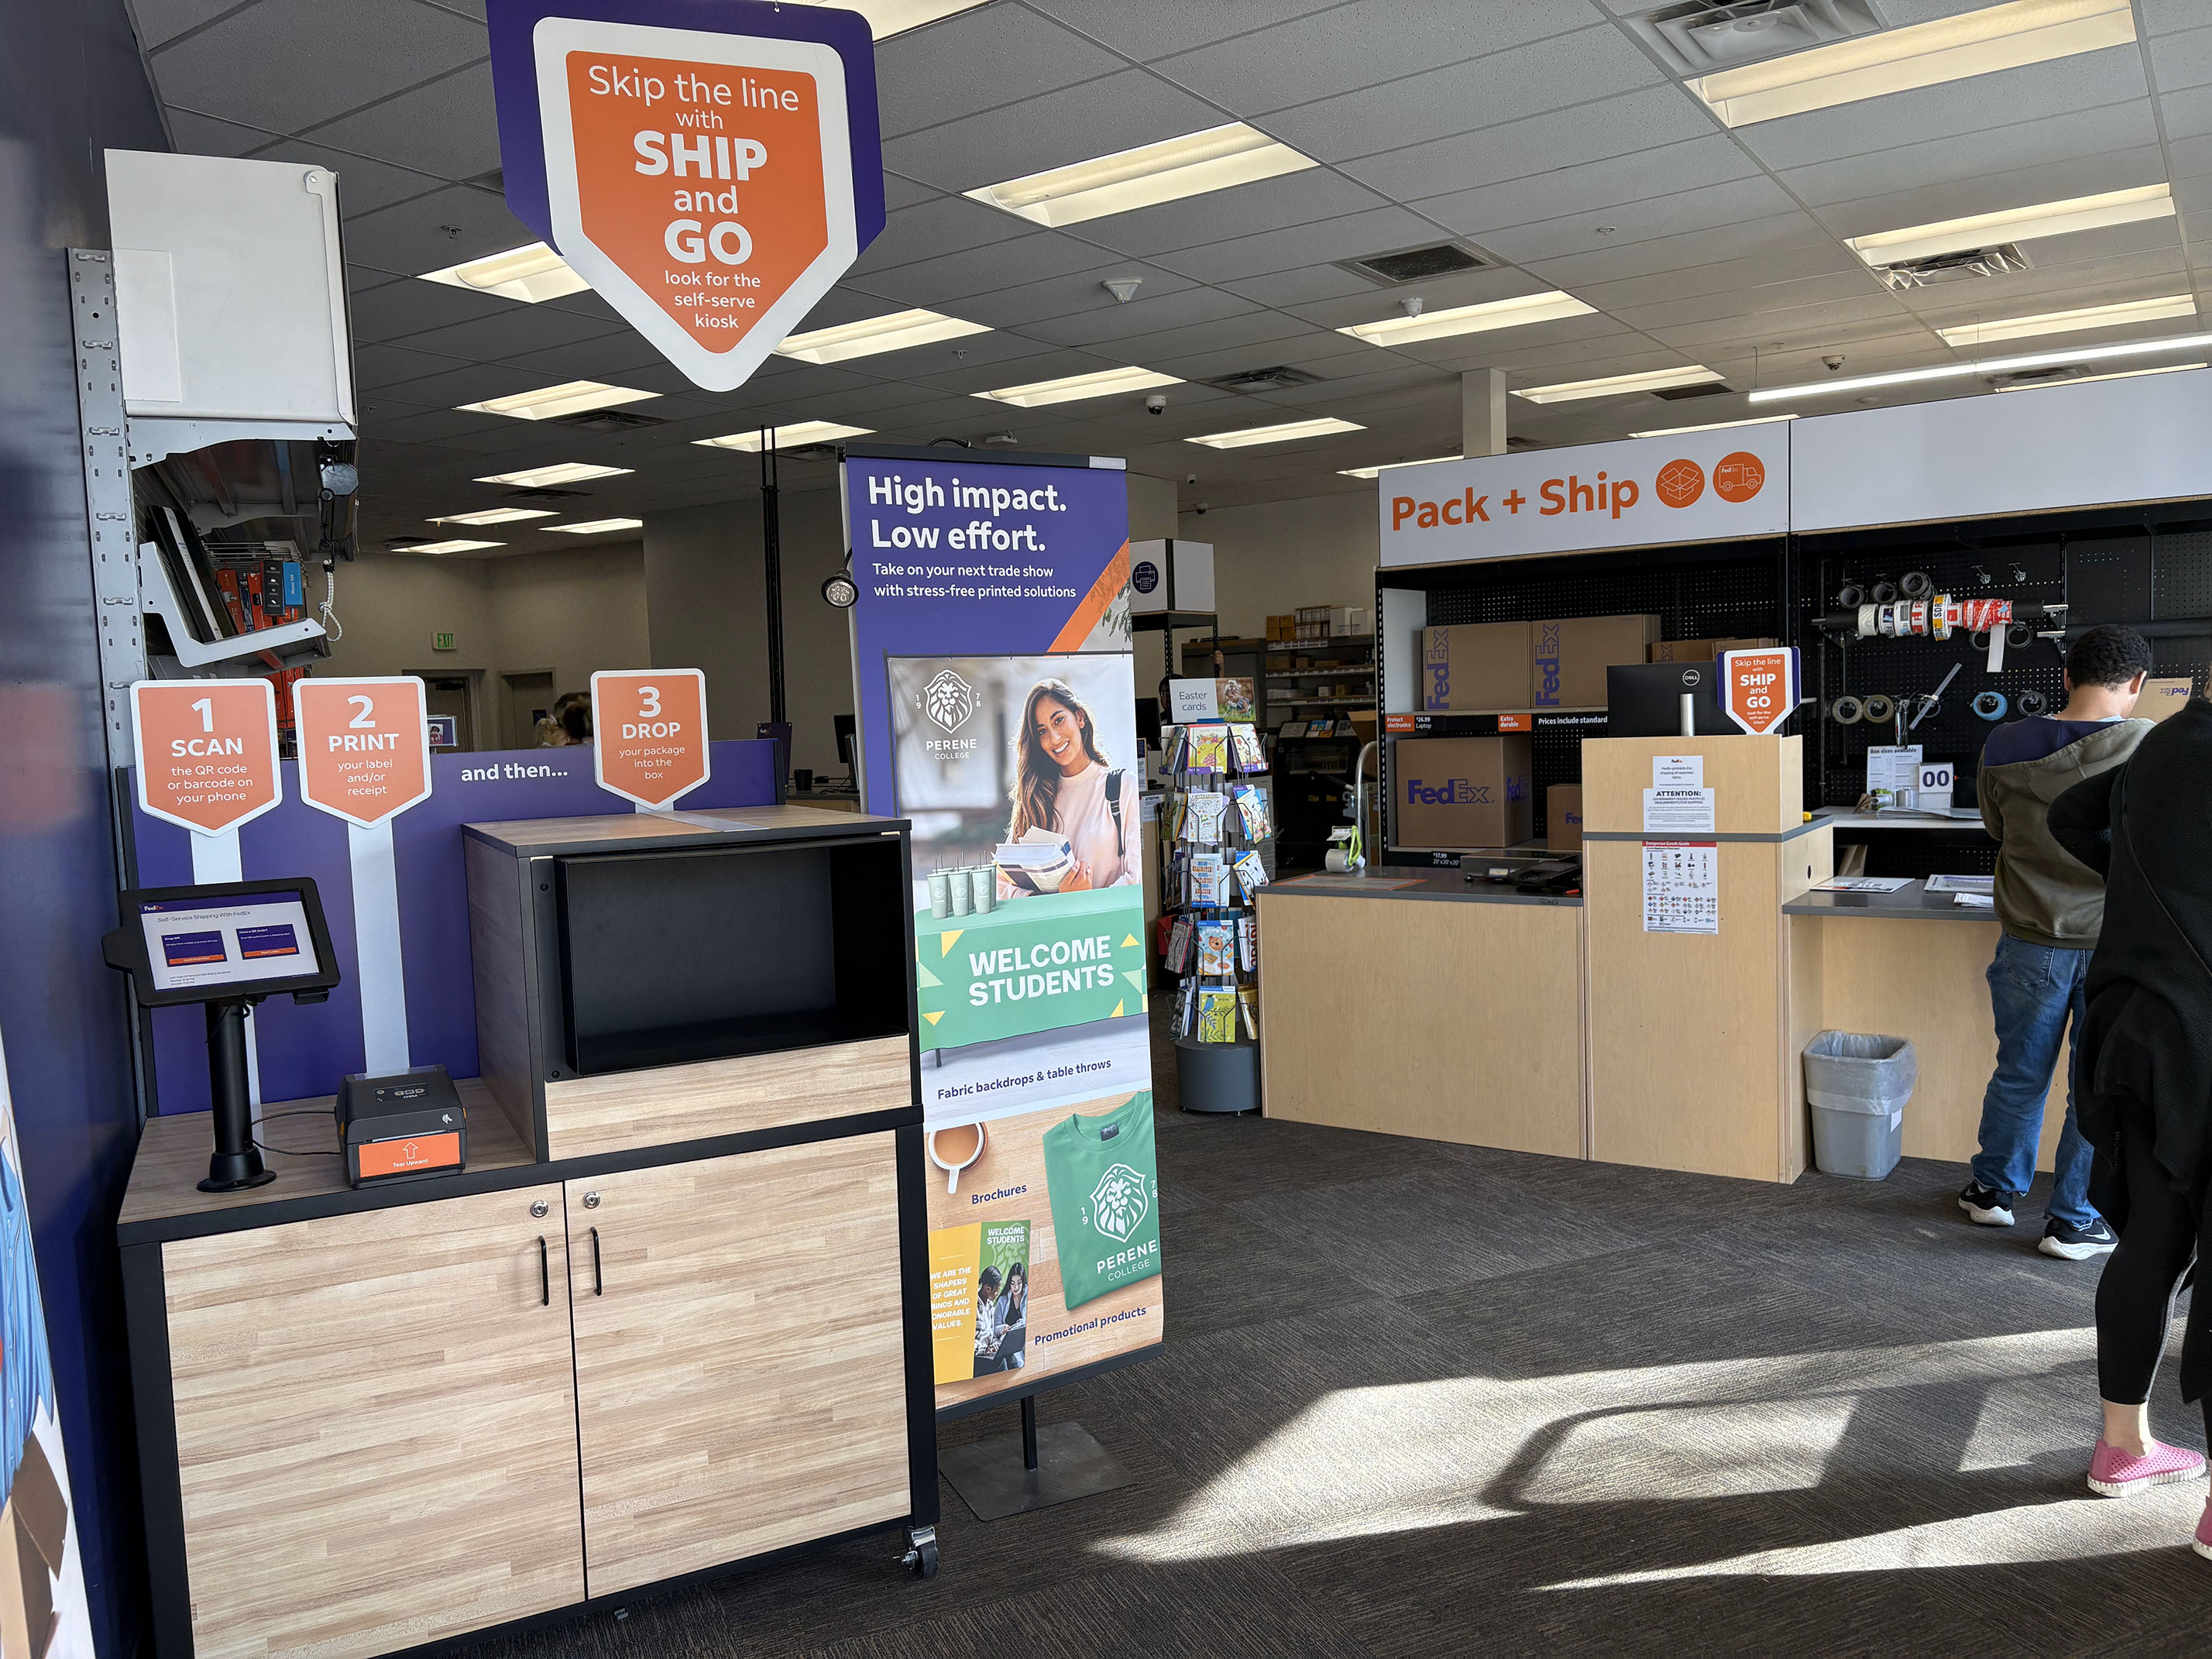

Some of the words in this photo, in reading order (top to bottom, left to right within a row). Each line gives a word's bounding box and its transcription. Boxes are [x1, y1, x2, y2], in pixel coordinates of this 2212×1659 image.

[589, 65, 665, 107] Skip
[675, 74, 731, 105] the
[742, 78, 799, 112] line
[675, 109, 723, 129] with
[634, 131, 768, 181] SHIP
[674, 186, 738, 214] and
[665, 220, 752, 265] GO
[665, 270, 700, 287] look
[706, 273, 730, 287] for
[733, 274, 761, 288] the
[675, 293, 755, 308] self-serve
[695, 314, 739, 328] kiosk
[868, 475, 945, 514] High
[953, 478, 1066, 517] impact.
[1393, 486, 1490, 531] Pack
[1503, 489, 1526, 514] +
[1539, 471, 1640, 519] Ship
[871, 519, 939, 548] Low
[948, 520, 1046, 551] effort.
[873, 563, 904, 575] Take
[907, 565, 923, 576] on
[926, 565, 955, 579] your
[958, 565, 986, 577] next
[988, 565, 1020, 577] trade
[1023, 566, 1053, 577] show
[874, 585, 903, 596] with
[906, 586, 975, 597] stress-free
[978, 586, 1022, 599] printed
[1024, 586, 1076, 597] solutions
[438, 633, 454, 648] EXIT
[1427, 628, 1451, 709] FedEx
[1536, 623, 1560, 706] FedEx
[1740, 673, 1776, 686] SHIP
[638, 686, 661, 717] 3
[1179, 691, 1207, 699] Easter
[1747, 696, 1771, 708] GO
[347, 696, 376, 729] 2
[1182, 702, 1207, 711] cards
[191, 699, 214, 732] 1
[623, 722, 681, 739] DROP
[171, 738, 243, 757] SCAN
[328, 733, 399, 752] PRINT
[926, 739, 977, 750] PERENE
[620, 747, 641, 758] your
[644, 746, 685, 757] package
[171, 767, 191, 776] the
[195, 765, 214, 775] QR
[218, 764, 247, 774] code
[338, 761, 362, 772] your
[366, 759, 393, 769] label
[634, 759, 653, 768] into
[655, 758, 672, 767] the
[348, 773, 386, 783] and/or
[461, 764, 499, 781] and
[503, 763, 568, 779] then...
[644, 771, 663, 779] box
[1922, 771, 1949, 787] 00
[168, 781, 180, 790] or
[184, 778, 234, 789] barcode
[348, 785, 386, 796] receipt
[1408, 778, 1490, 805] FedEx
[177, 794, 204, 805] your
[208, 792, 246, 803] phone
[969, 935, 1111, 977] WELCOME
[969, 963, 1114, 1007] STUDENTS
[938, 1083, 973, 1100] Fabric
[976, 1073, 1034, 1095] backdrops
[1036, 1070, 1045, 1080] &
[1046, 1064, 1073, 1078] table
[1076, 1059, 1111, 1074] throws
[972, 1183, 1027, 1204] Brochures
[988, 1227, 1025, 1236] WELCOME
[987, 1235, 1025, 1245] STUDENTS
[1097, 1239, 1157, 1273] PERENE
[958, 1266, 972, 1275] THE
[1108, 1259, 1150, 1281] COLLEGE
[933, 1278, 967, 1290] SHAPERS
[943, 1288, 967, 1298] GREAT
[954, 1298, 970, 1307] AND
[933, 1320, 963, 1330] VALUES.
[1034, 1317, 1098, 1345] Promotional
[1101, 1306, 1147, 1328] products
